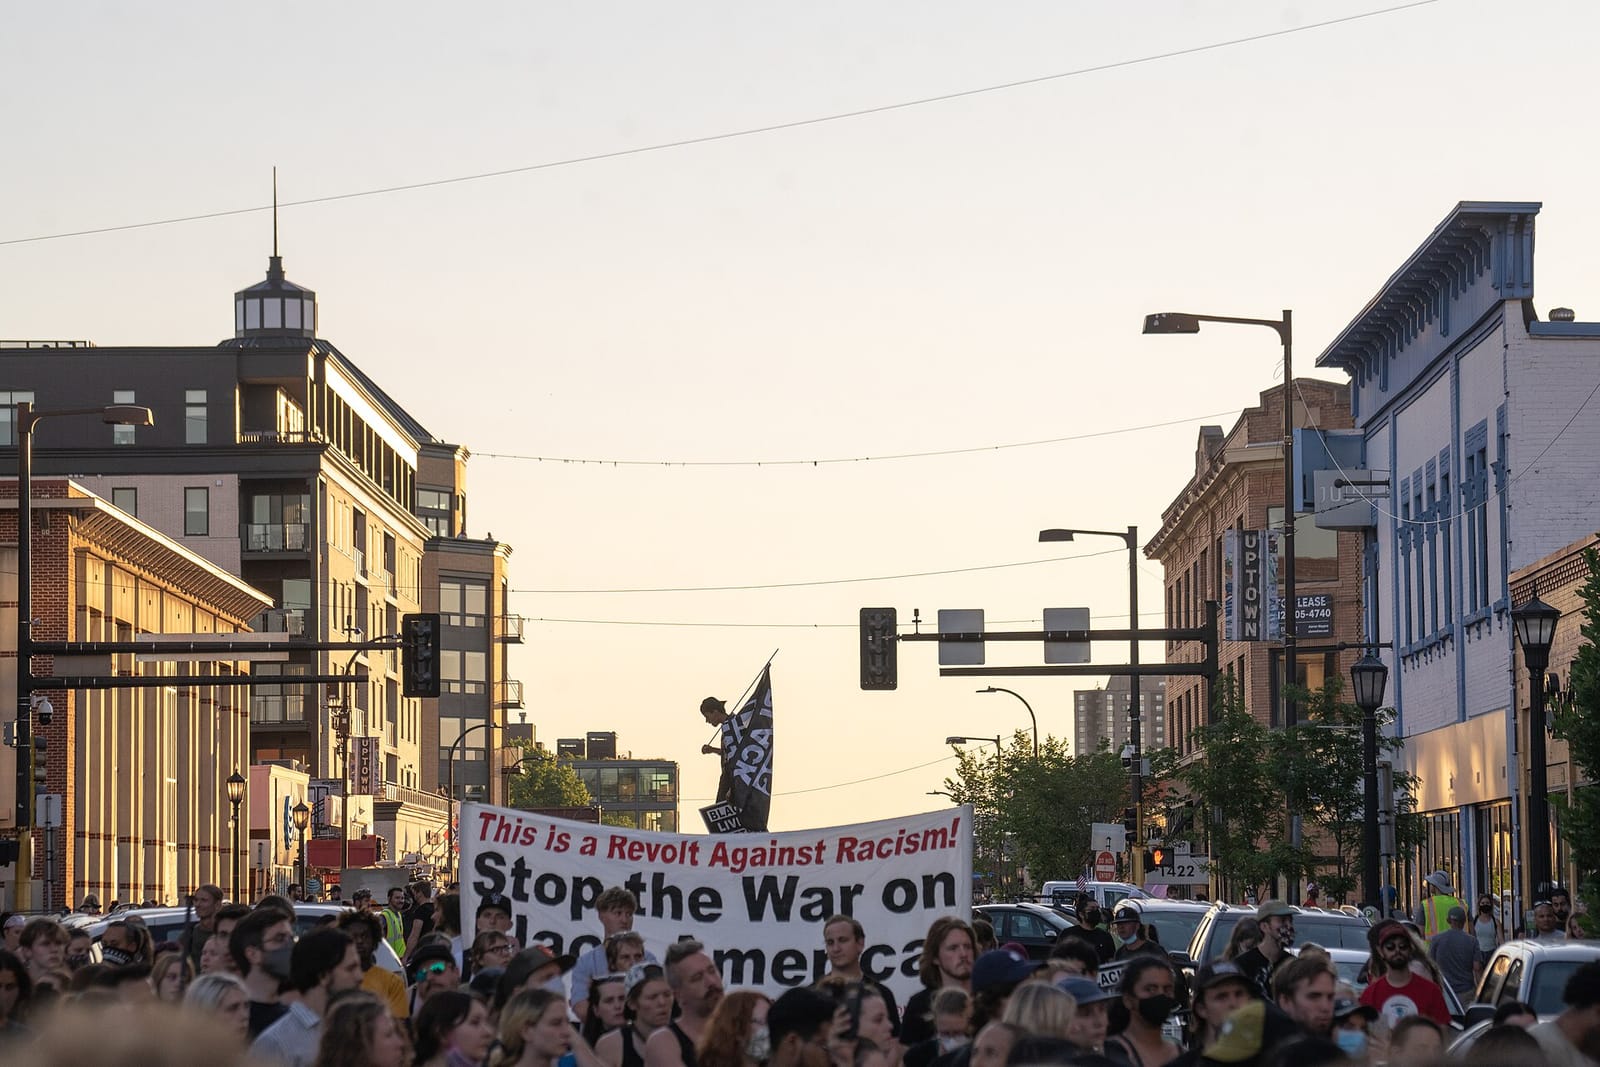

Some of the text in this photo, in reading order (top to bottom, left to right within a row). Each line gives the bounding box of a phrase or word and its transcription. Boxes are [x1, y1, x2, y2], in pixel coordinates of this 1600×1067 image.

[1244, 534, 1258, 637] UPTOWN
[1297, 596, 1327, 608] LEASE
[361, 739, 369, 794] UPTOWN
[709, 805, 738, 821] BLA
[717, 816, 741, 832] LIV
[479, 811, 960, 874] This is a Revolt Against Racism!
[473, 850, 957, 923] Stop the War on
[1160, 865, 1195, 878] 1422
